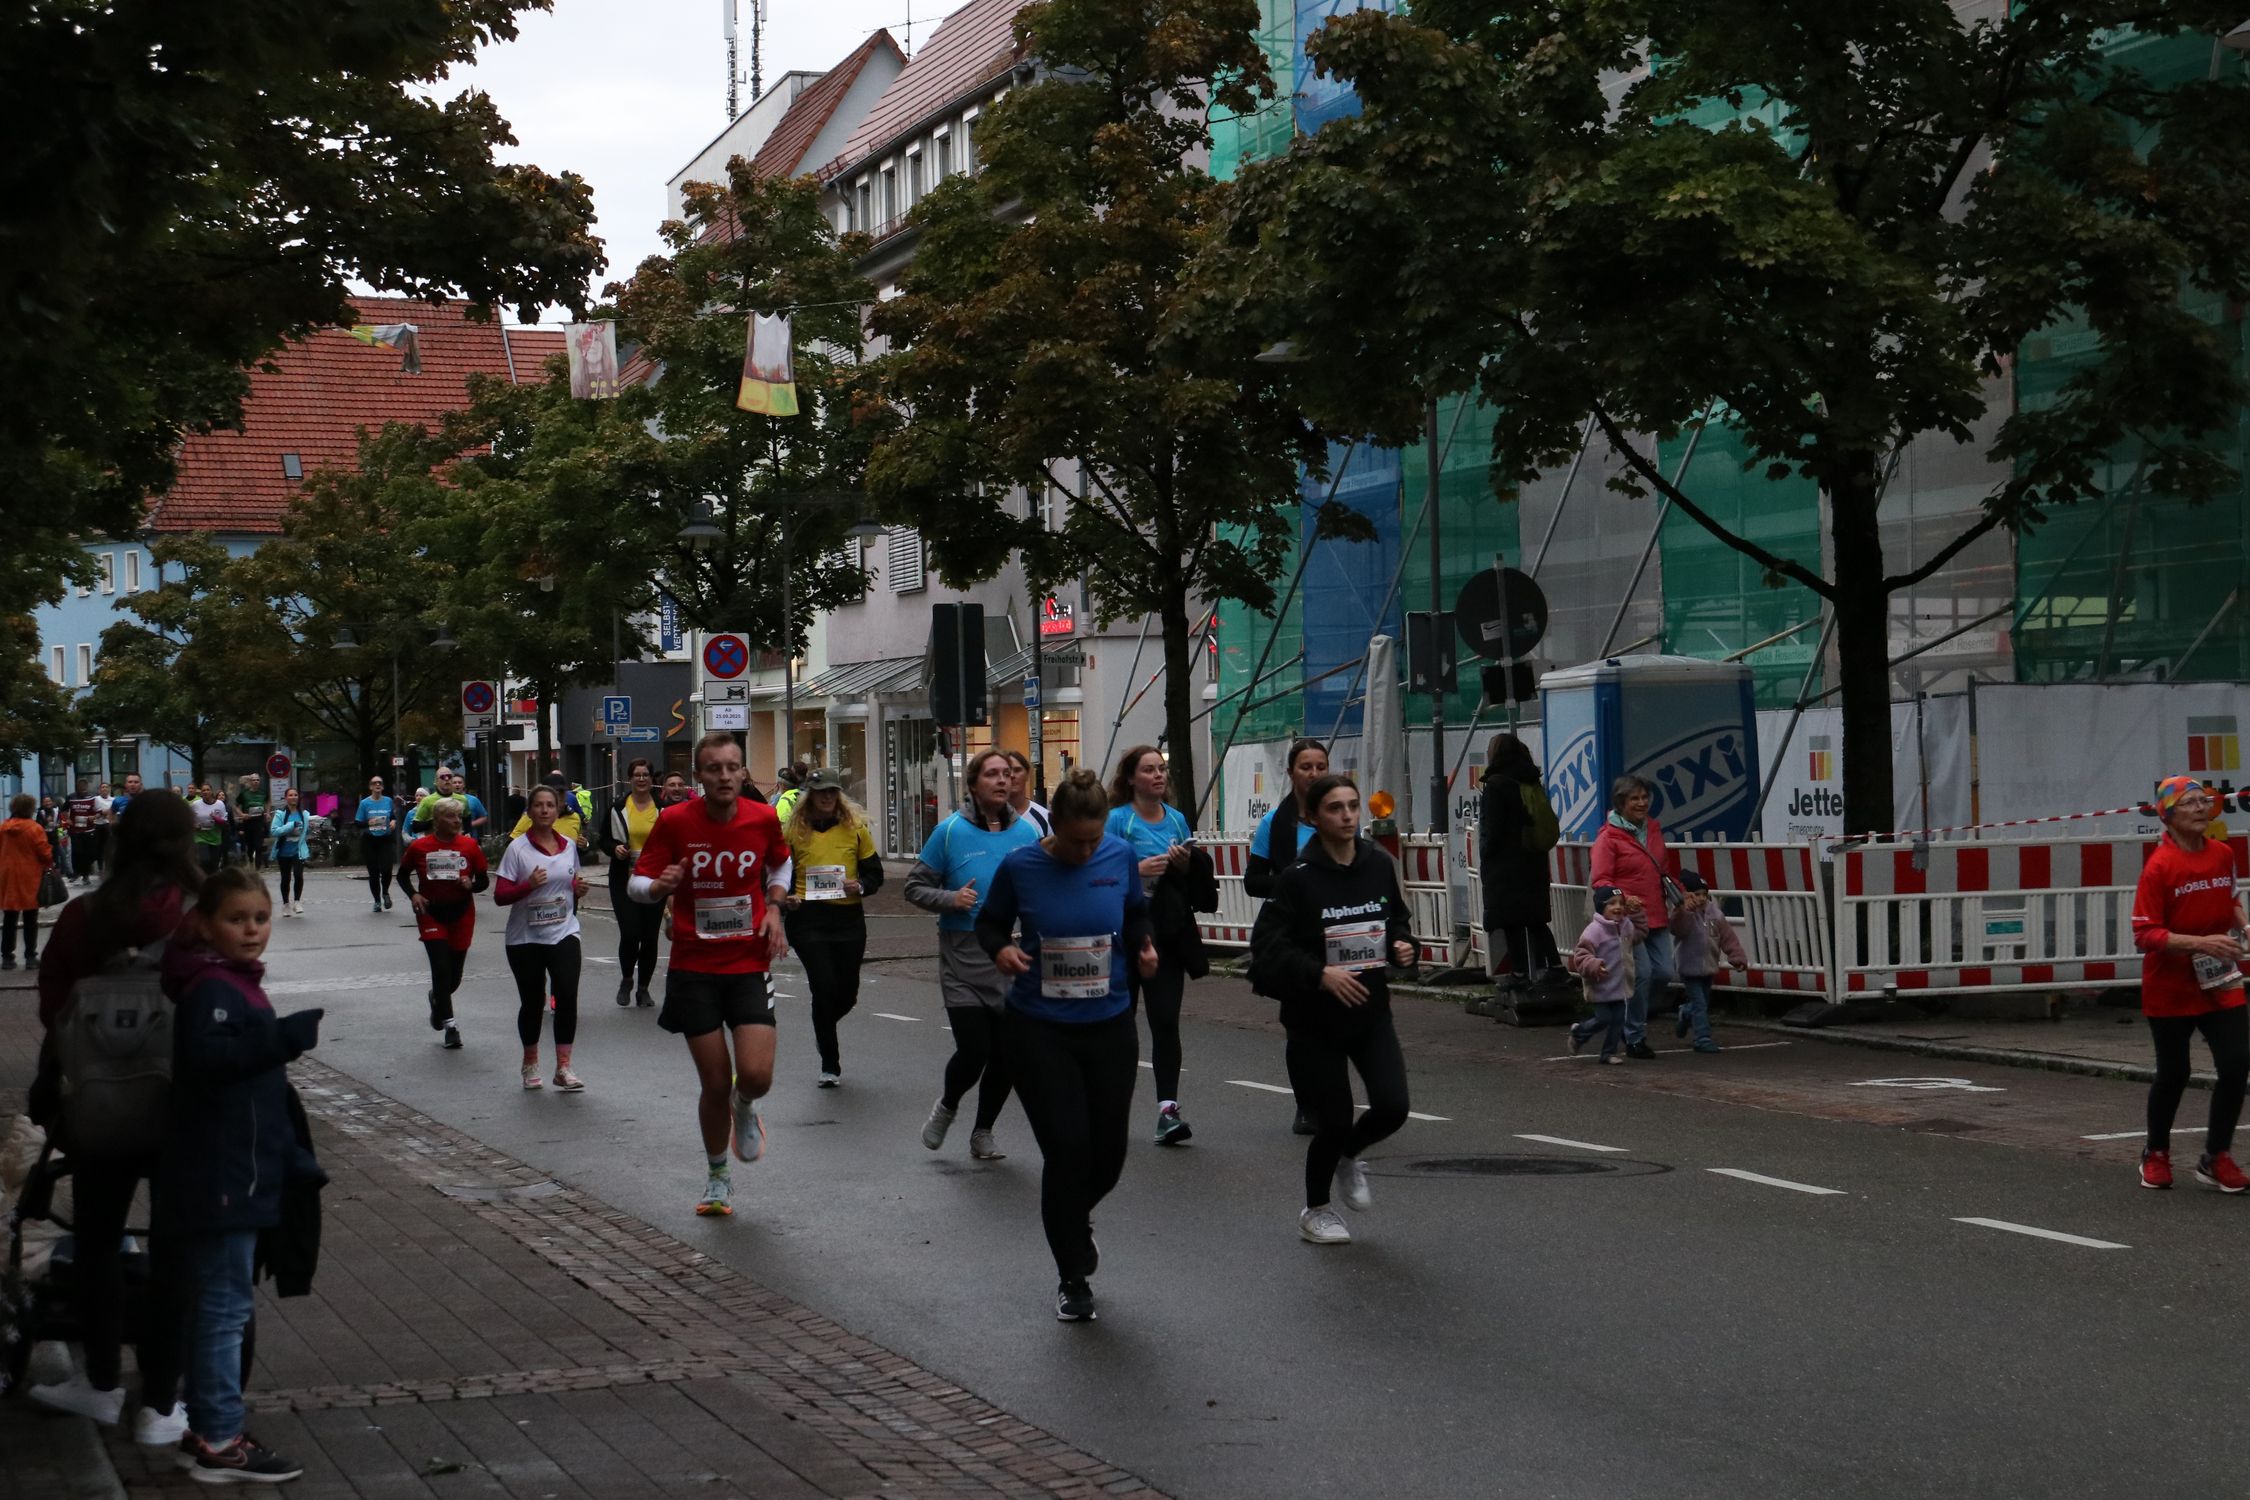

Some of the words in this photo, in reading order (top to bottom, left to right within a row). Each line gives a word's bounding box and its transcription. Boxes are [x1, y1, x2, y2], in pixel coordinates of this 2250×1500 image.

[1044, 654, 1078, 664] Freihofstr.
[610, 701, 624, 720] P
[1788, 788, 1842, 816] Jette
[692, 881, 724, 889] BIOZIDE
[814, 880, 836, 889] Karin
[2175, 880, 2211, 897] MÖBEL
[1321, 900, 1382, 919] Alphartis
[704, 917, 743, 930] Jannis
[1339, 947, 1376, 961] Maria
[1053, 962, 1099, 977] Nicole
